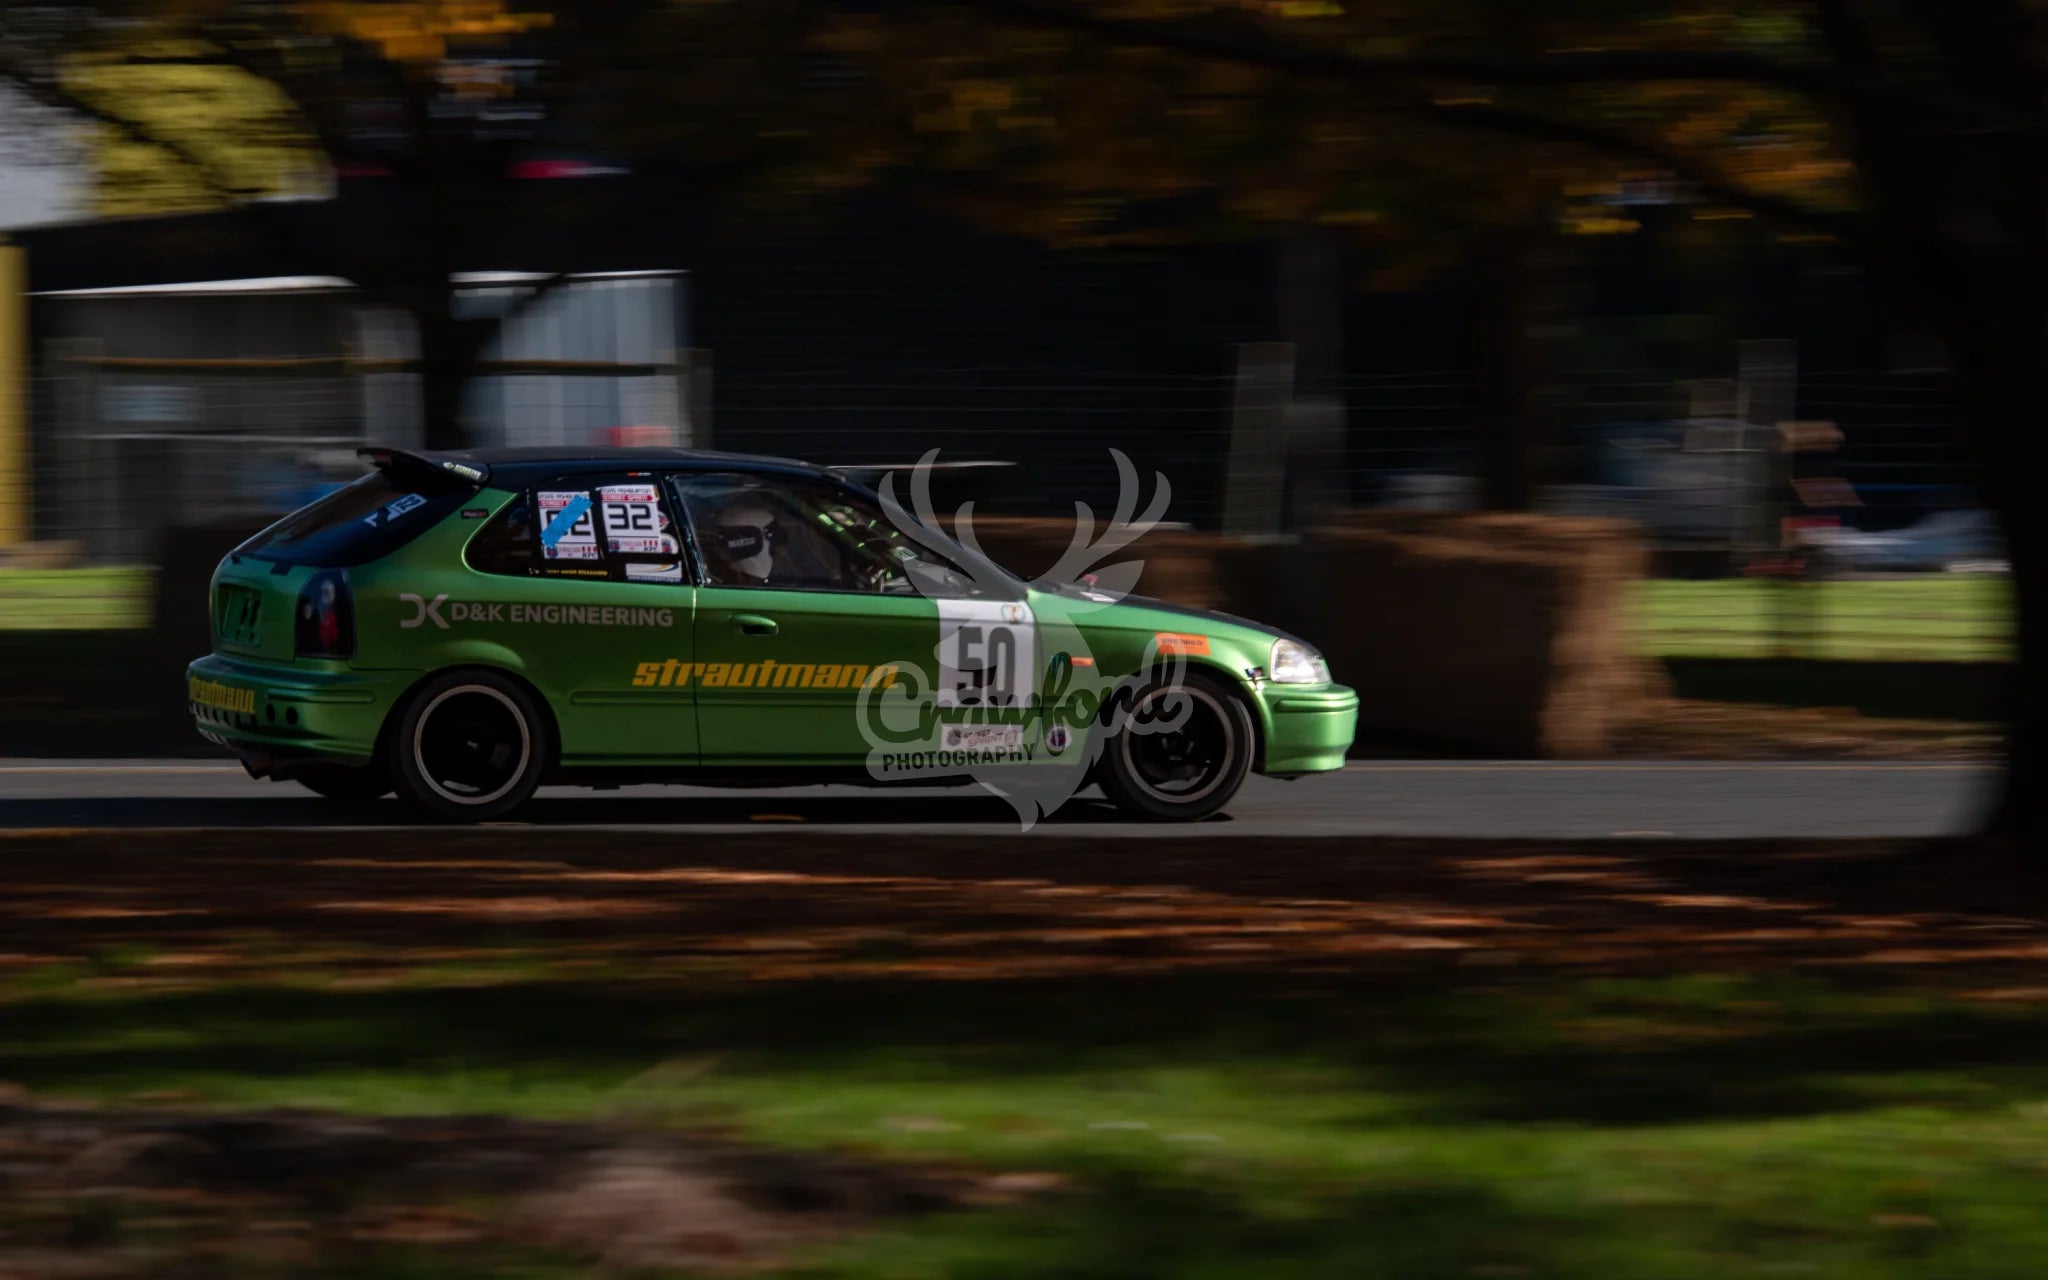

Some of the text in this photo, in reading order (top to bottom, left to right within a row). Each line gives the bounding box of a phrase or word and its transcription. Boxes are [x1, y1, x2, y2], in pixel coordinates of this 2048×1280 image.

[607, 503, 653, 531] 32
[451, 602, 674, 628] D&K ENGINEERING
[631, 658, 901, 690] strautmann
[956, 625, 1015, 706] 50
